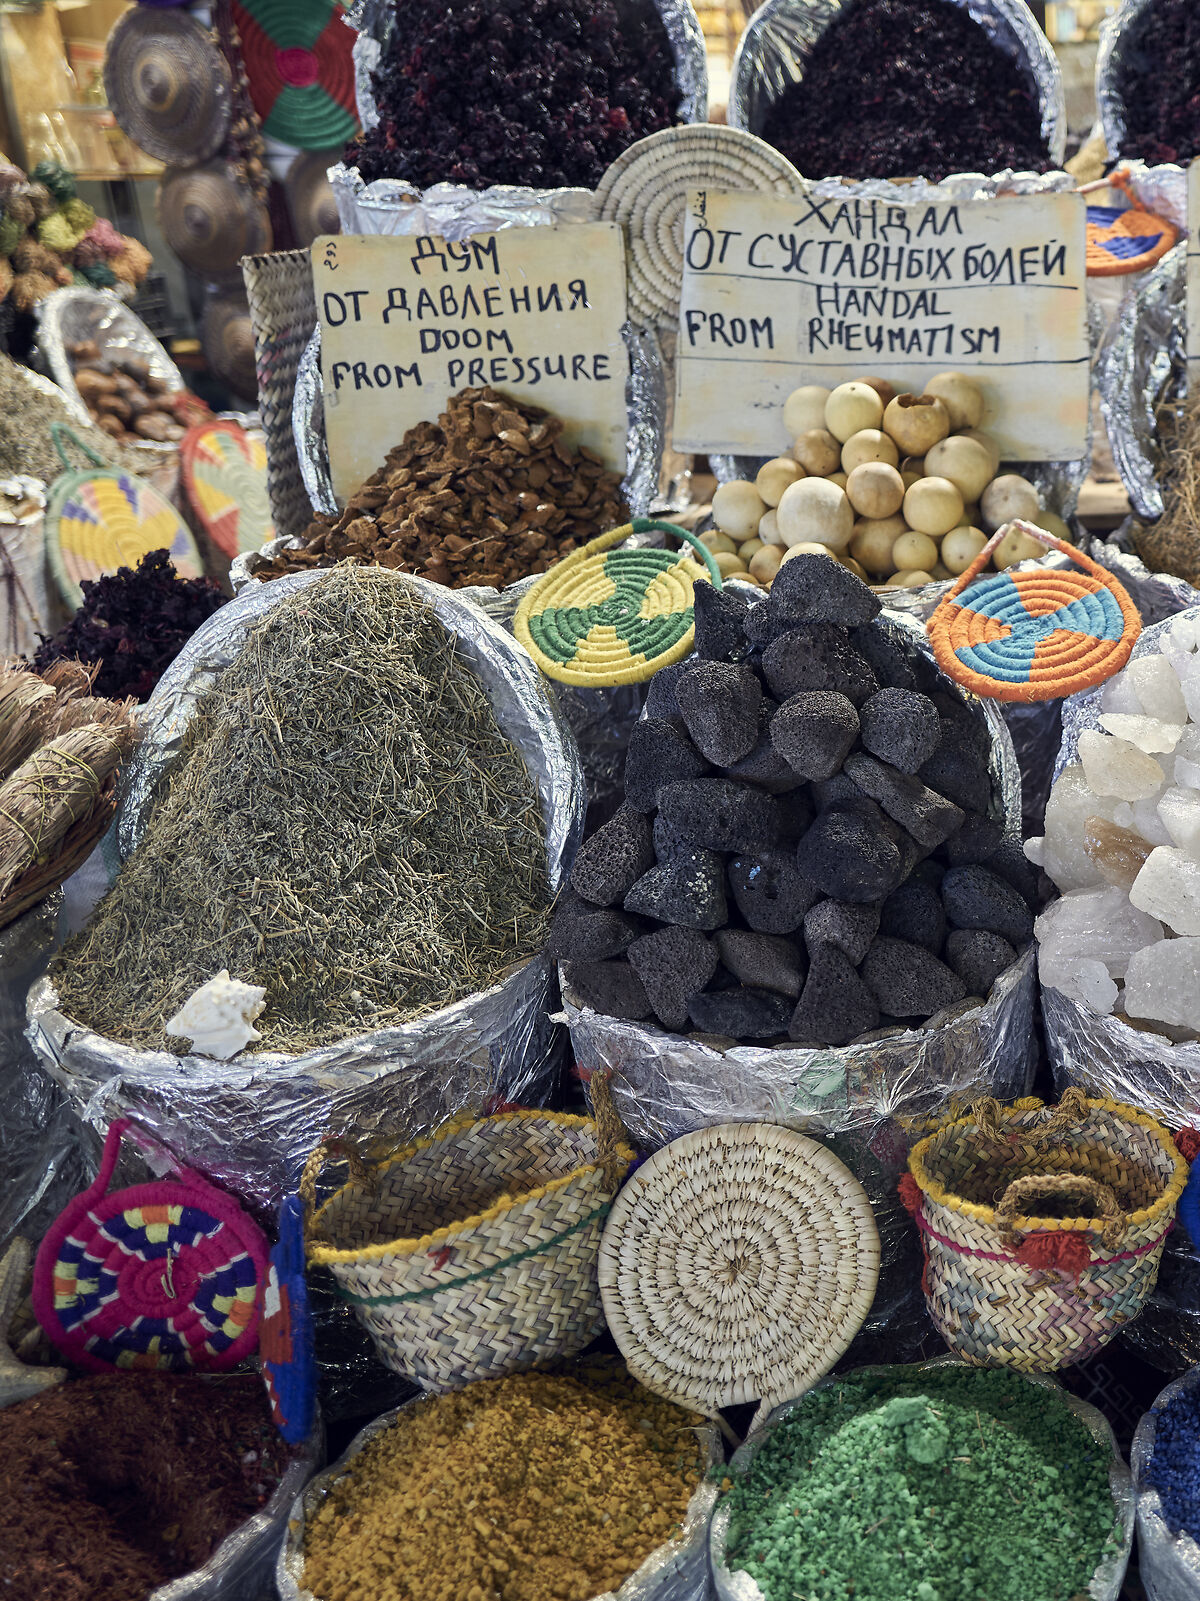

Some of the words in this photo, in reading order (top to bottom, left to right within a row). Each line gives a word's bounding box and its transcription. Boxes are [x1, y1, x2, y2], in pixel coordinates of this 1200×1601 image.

[794, 194, 962, 244] ХАНДАЛ
[411, 236, 499, 274] ДУМ
[686, 229, 741, 270] ОТ
[963, 240, 1066, 285] БОЛЕЙ
[323, 291, 369, 326] ОТ
[383, 280, 591, 323] ДАВЛЕНИЯ
[816, 283, 951, 318] HANDAL
[420, 329, 513, 353] DOOM
[686, 310, 773, 349] FROM
[809, 317, 1001, 356] RHEUMATISM
[332, 362, 422, 389] FROM
[448, 355, 611, 387] PRESSURE
